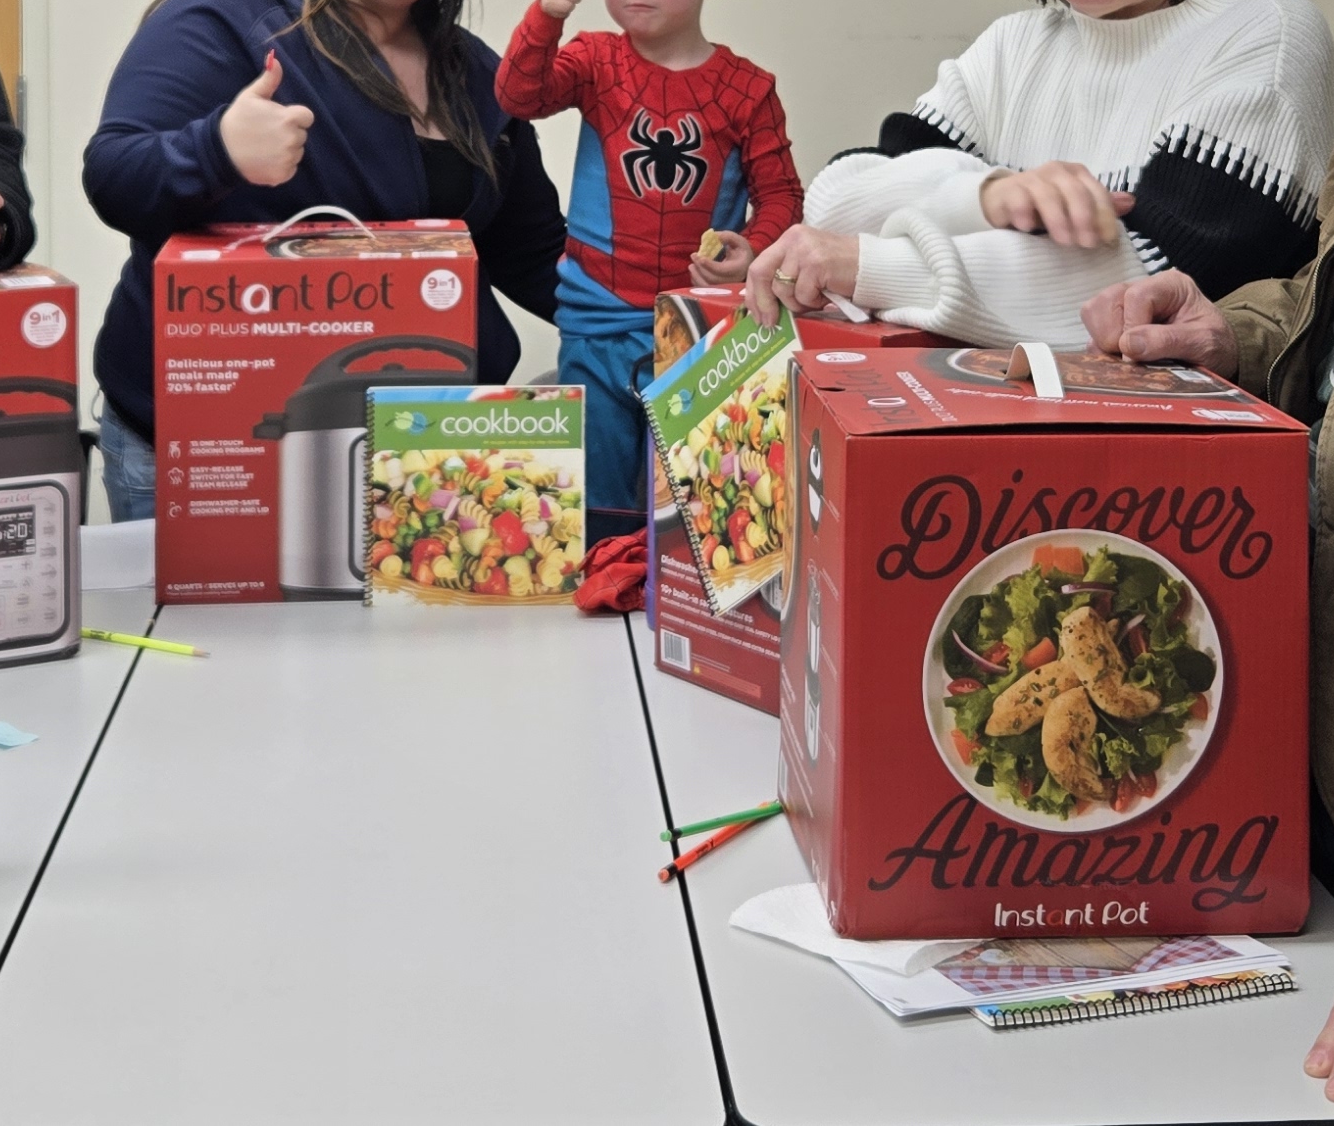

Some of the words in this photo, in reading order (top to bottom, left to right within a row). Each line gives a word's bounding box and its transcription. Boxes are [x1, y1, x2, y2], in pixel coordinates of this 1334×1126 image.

[427, 277, 438, 290] 9
[448, 277, 456, 290] 1
[166, 273, 315, 315] Instant
[327, 271, 395, 311] Pot
[29, 311, 41, 325] 9
[51, 309, 60, 323] 1
[210, 323, 250, 335] PLUS
[253, 321, 375, 335] MULTI-COOKER
[167, 359, 223, 370] Delicious
[226, 358, 276, 371] one-pot
[167, 371, 203, 381] meals
[206, 371, 240, 381] made
[167, 382, 193, 392] 70%
[440, 407, 570, 435] cookbook
[876, 469, 1273, 581] Discover
[868, 792, 1280, 913] Amazing
[994, 902, 1094, 928] Instant
[1102, 900, 1150, 927] Pot
